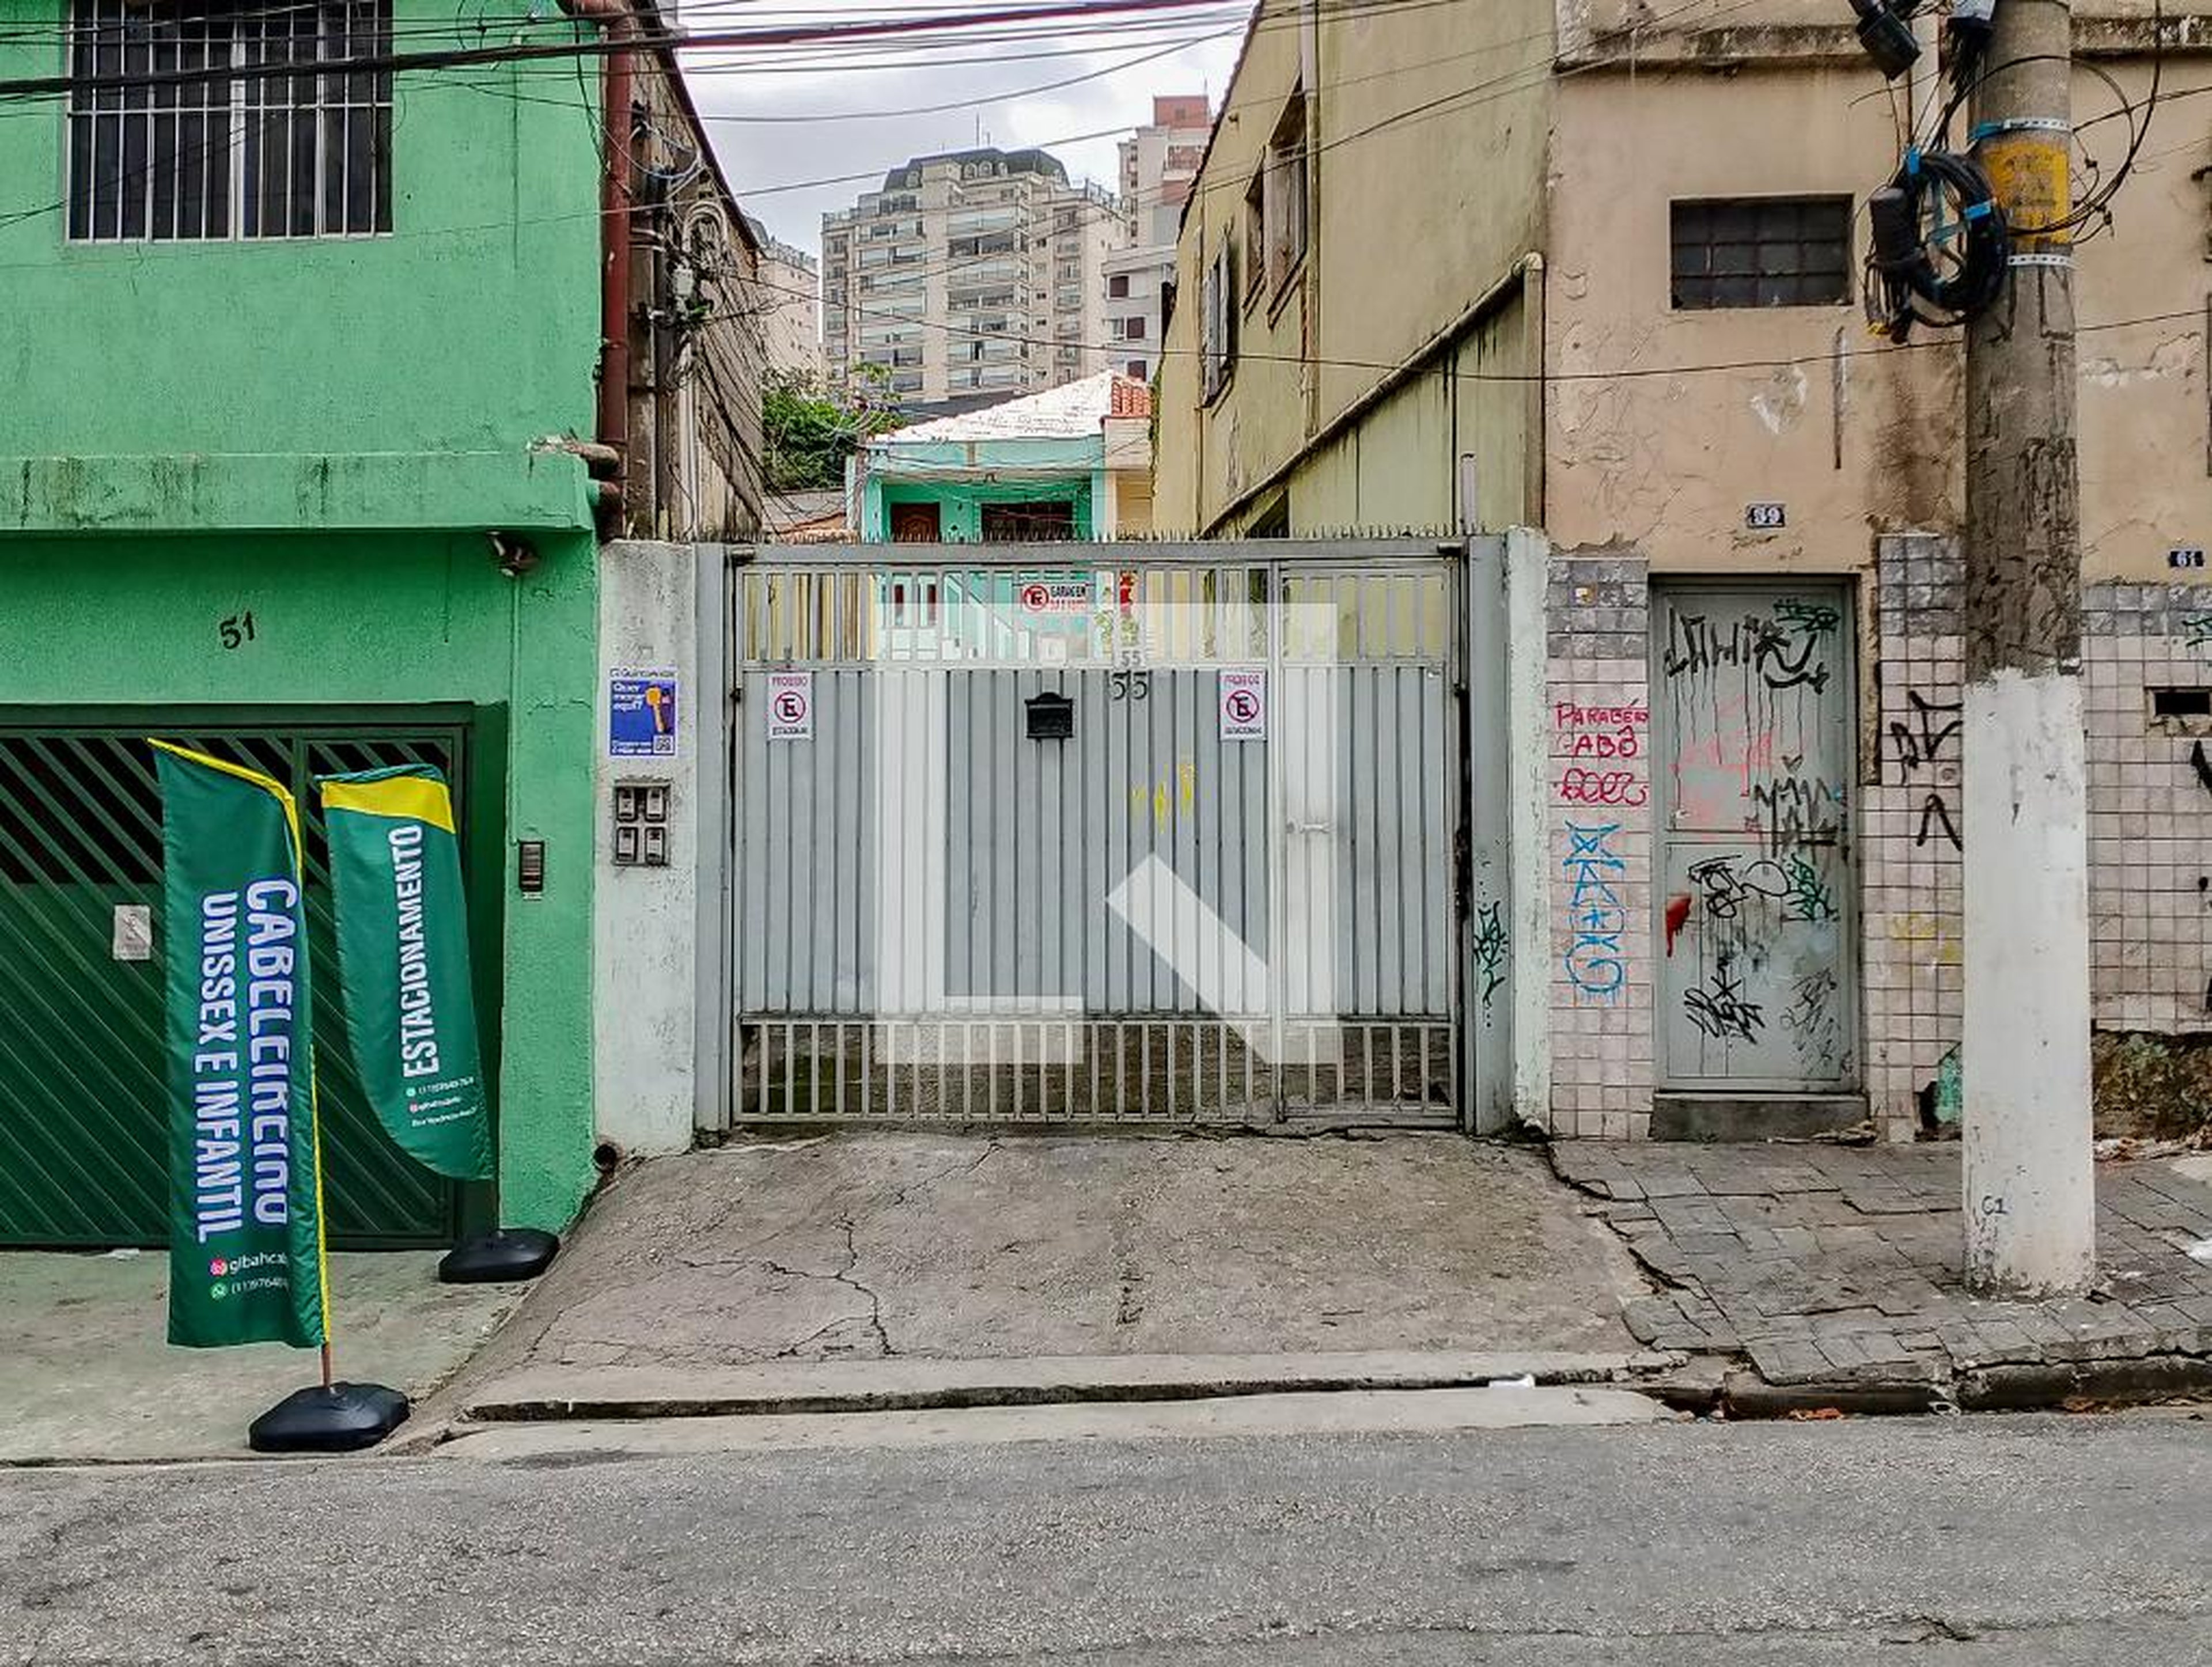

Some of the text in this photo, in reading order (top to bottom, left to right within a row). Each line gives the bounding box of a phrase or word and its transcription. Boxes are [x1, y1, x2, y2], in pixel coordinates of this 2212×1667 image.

[2176, 550, 2196, 567] 61
[219, 611, 255, 650] 51
[1121, 650, 1142, 667] 55
[1111, 671, 1147, 700] 55
[388, 824, 440, 1078] ESTACIONAMENTO
[195, 891, 243, 1244] UNISSEX E INFANTIL
